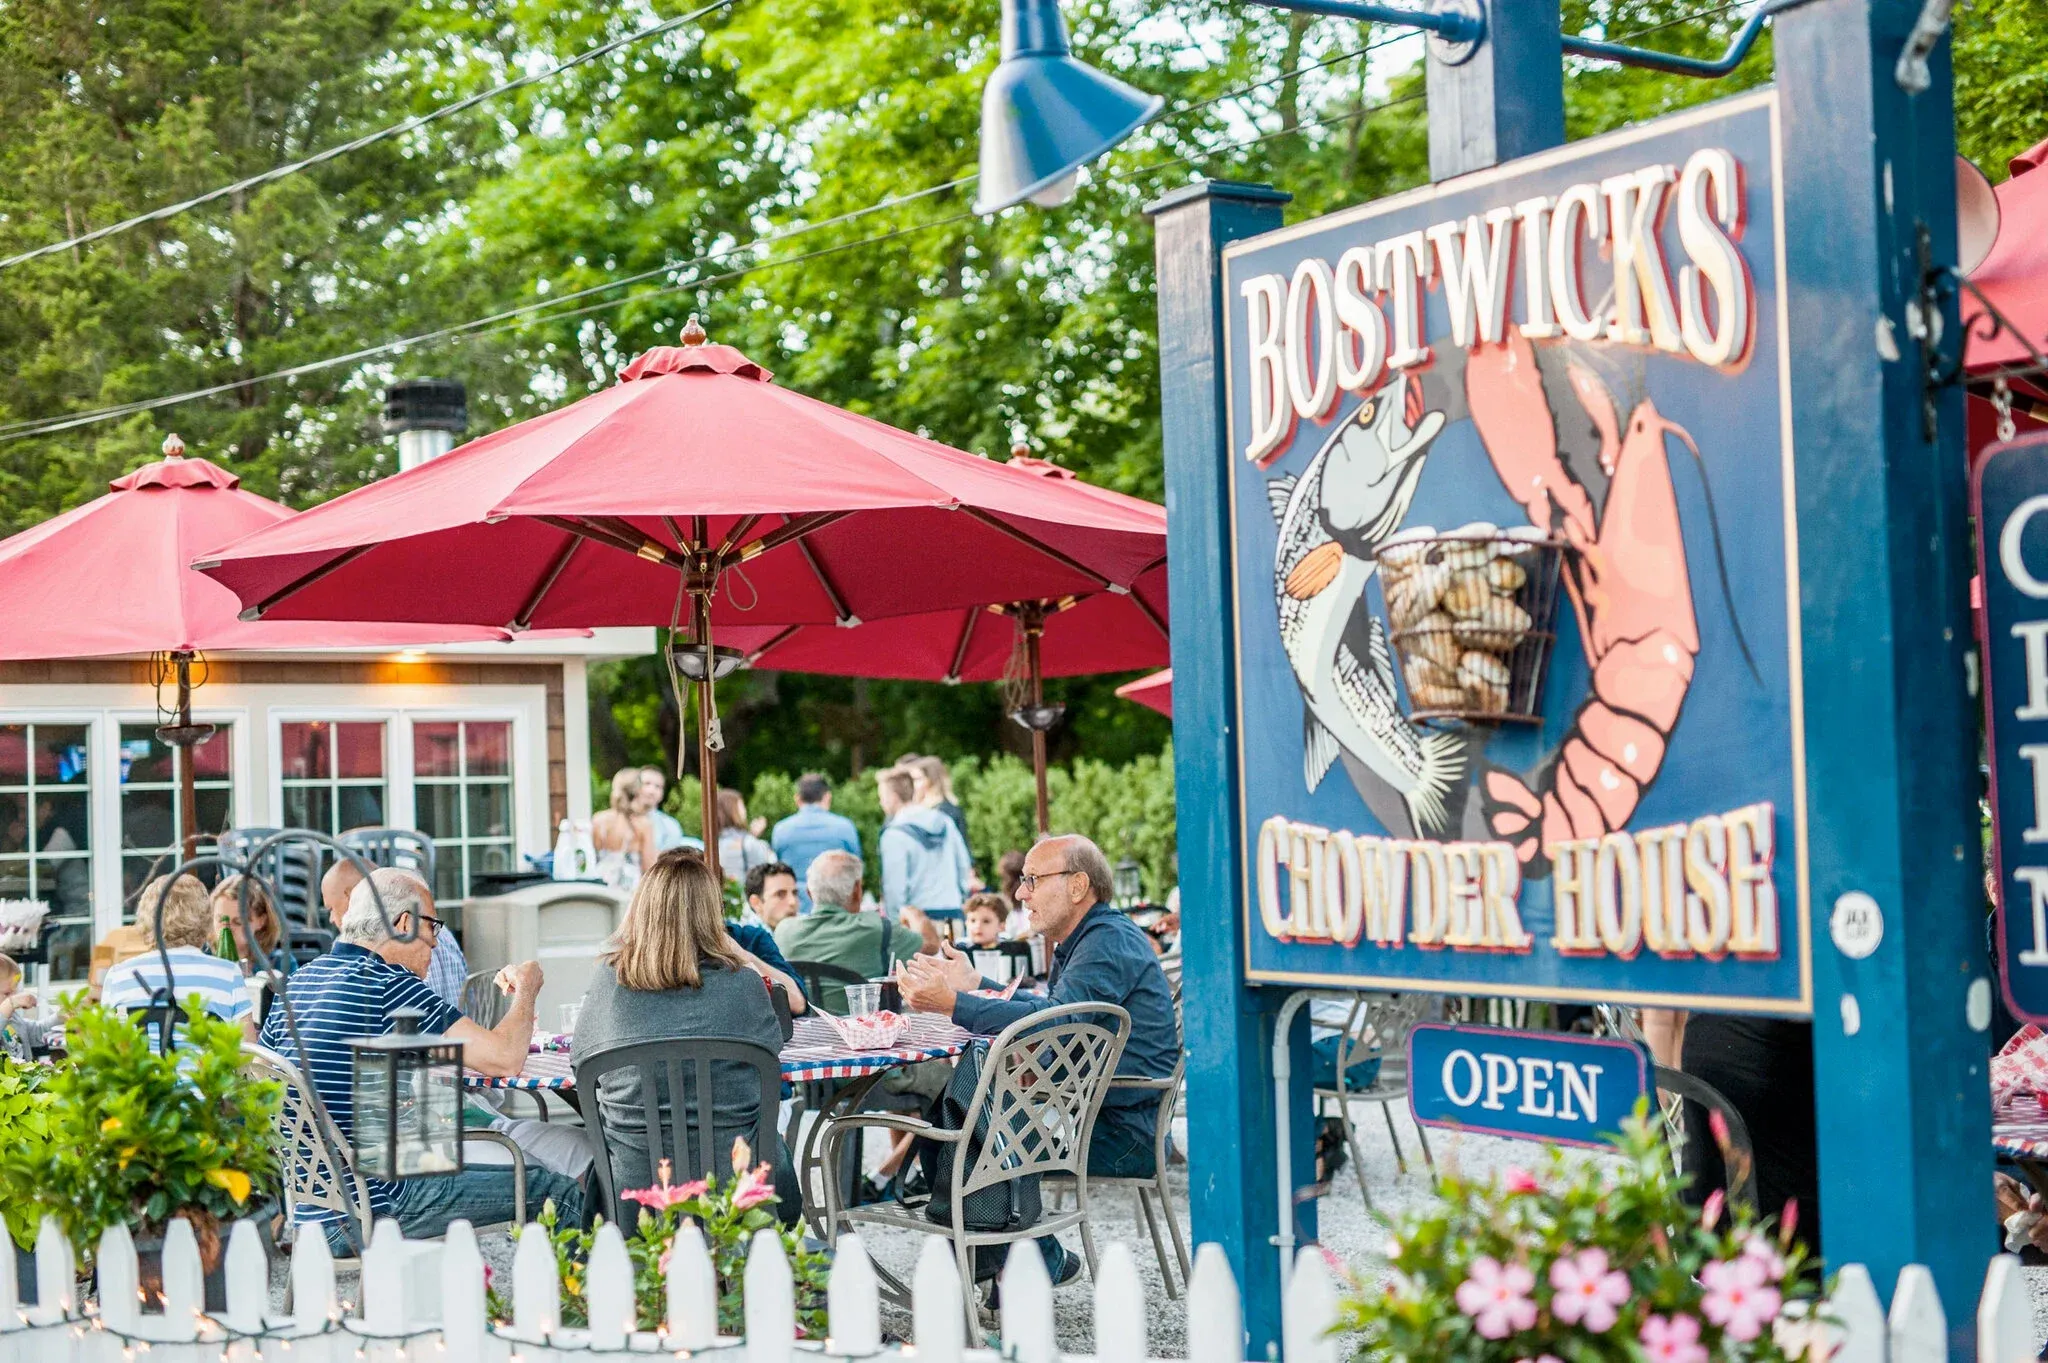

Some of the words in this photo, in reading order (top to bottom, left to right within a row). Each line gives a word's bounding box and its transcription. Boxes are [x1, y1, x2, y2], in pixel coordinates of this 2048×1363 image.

[1240, 147, 1756, 473] BOSTWICKS
[1257, 816, 1533, 955] CHOWDER
[1545, 801, 1782, 960] HOUSE
[1441, 1048, 1604, 1124] OPEN
